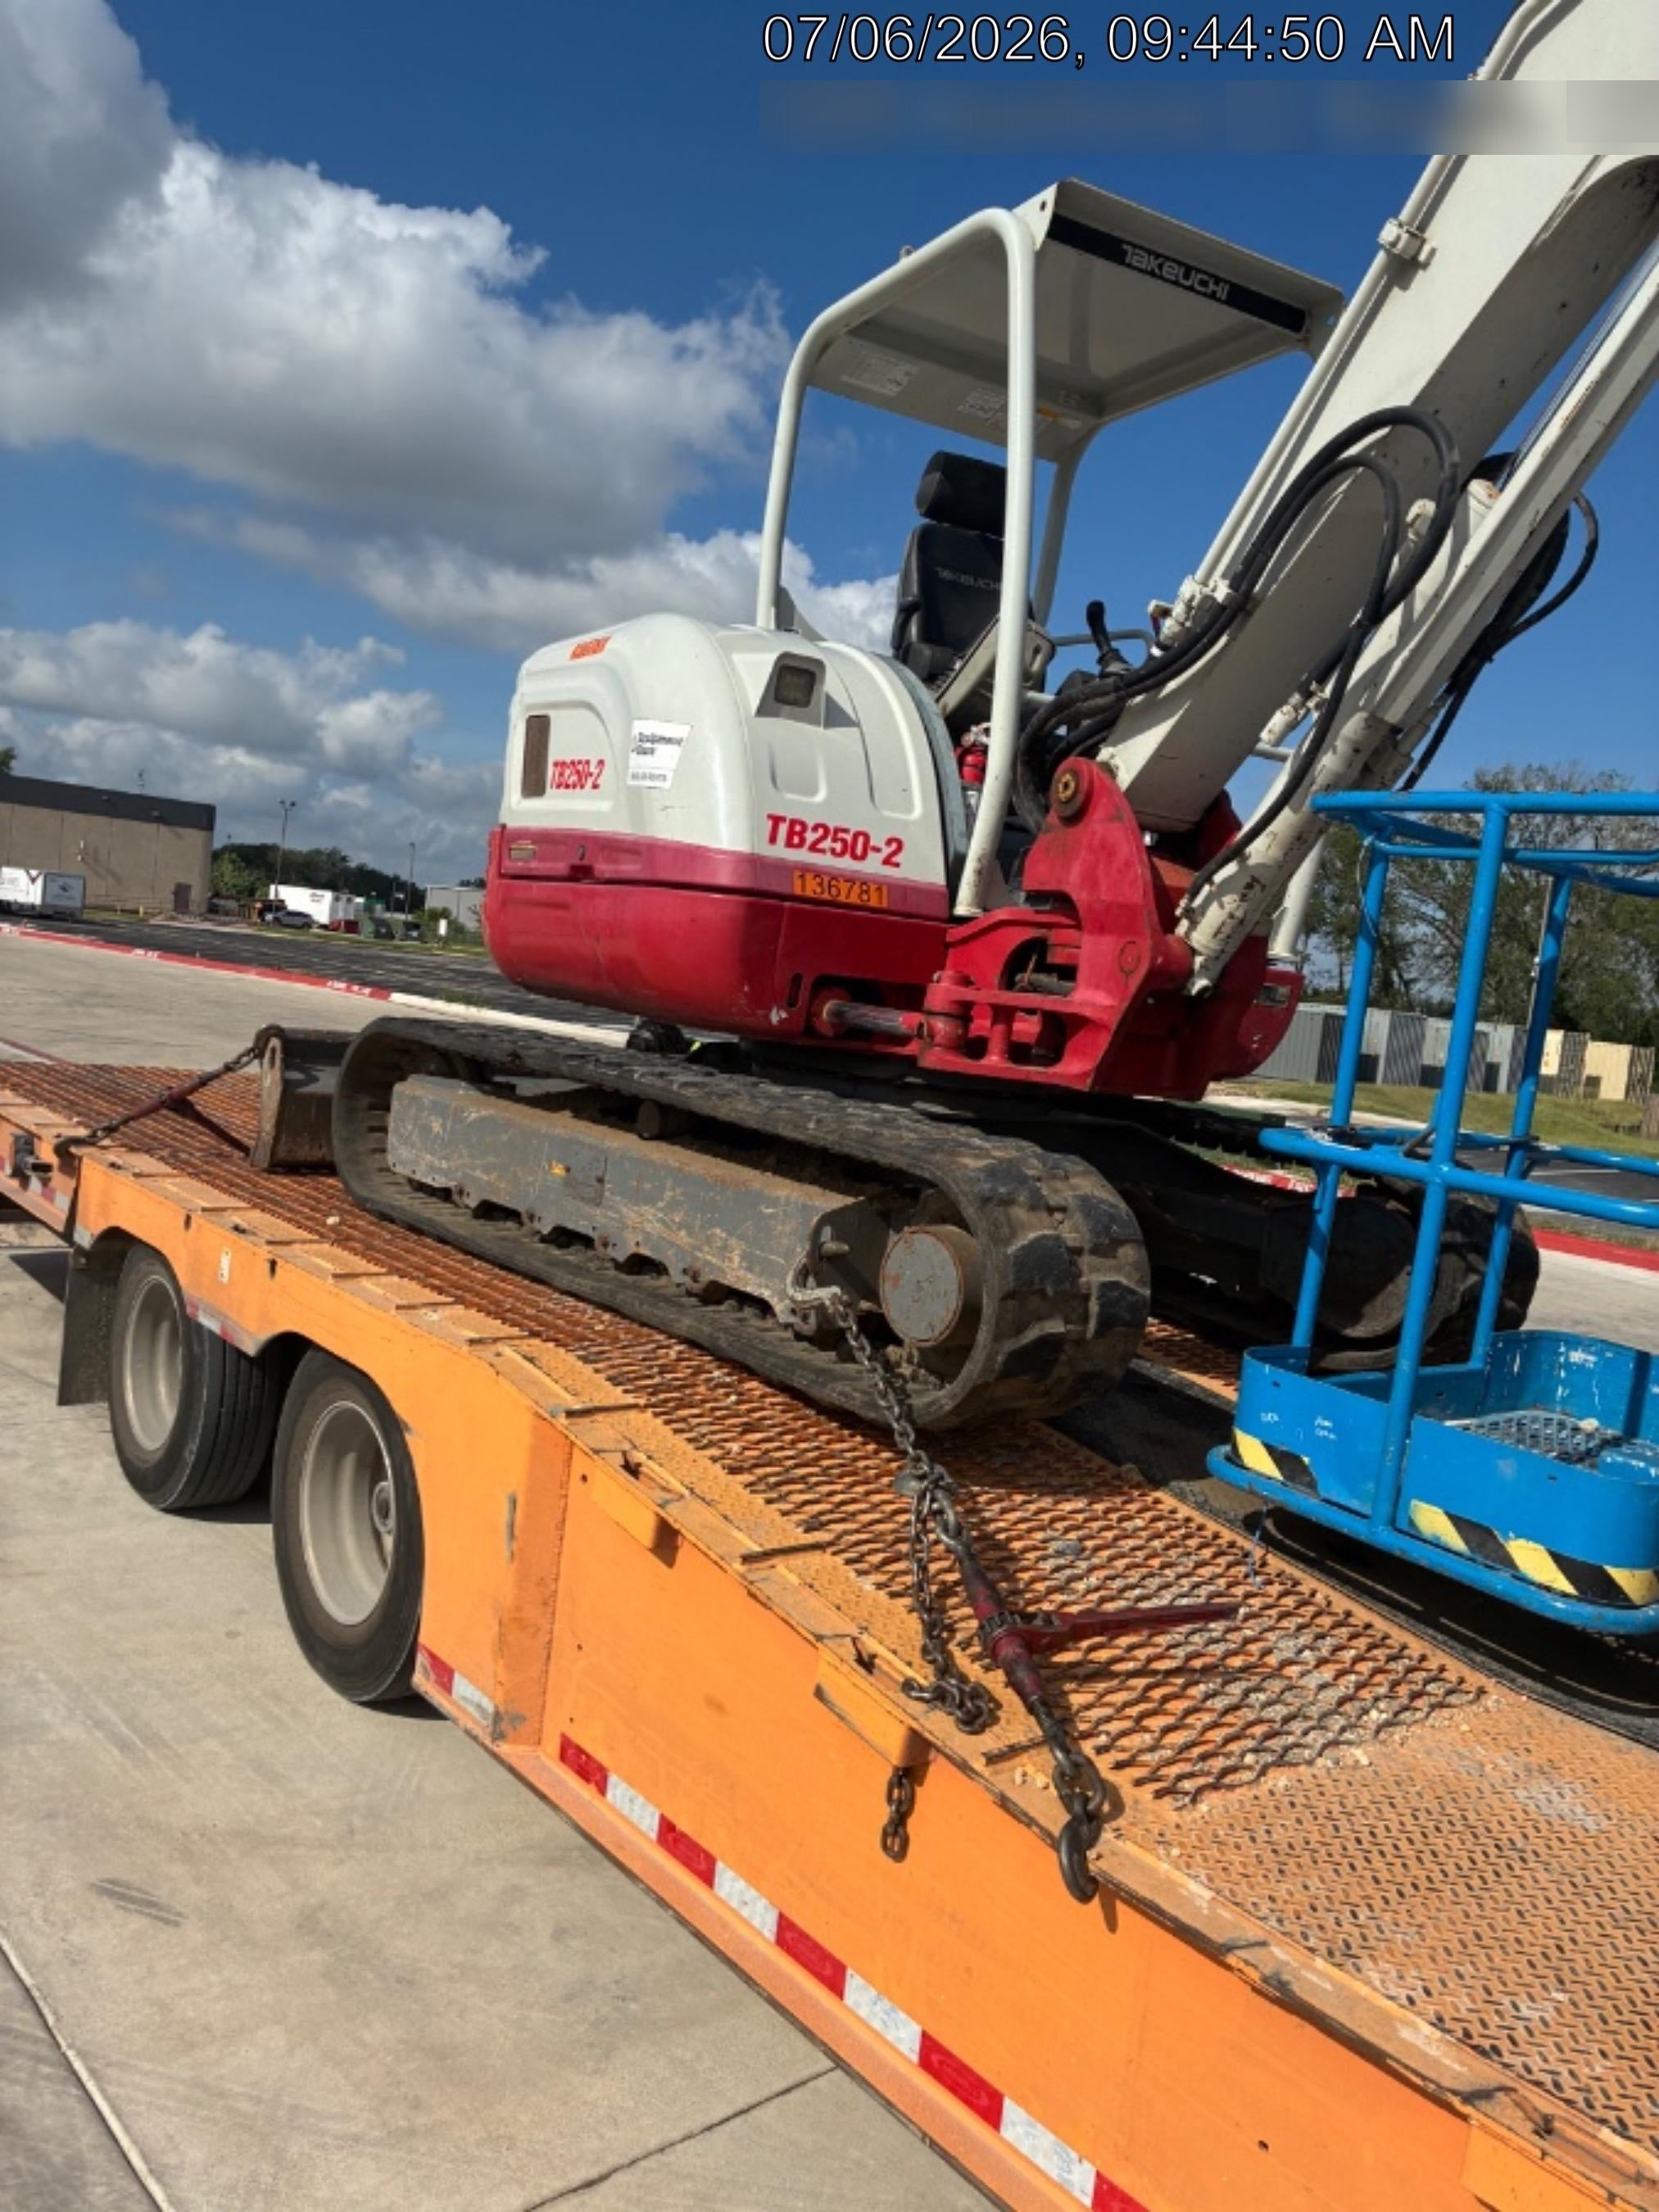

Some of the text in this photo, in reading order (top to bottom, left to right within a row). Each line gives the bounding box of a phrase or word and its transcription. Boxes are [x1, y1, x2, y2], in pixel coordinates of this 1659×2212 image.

[550, 758, 605, 790] TB250-2
[766, 813, 904, 868] TB250-2
[797, 873, 884, 905] 136781
